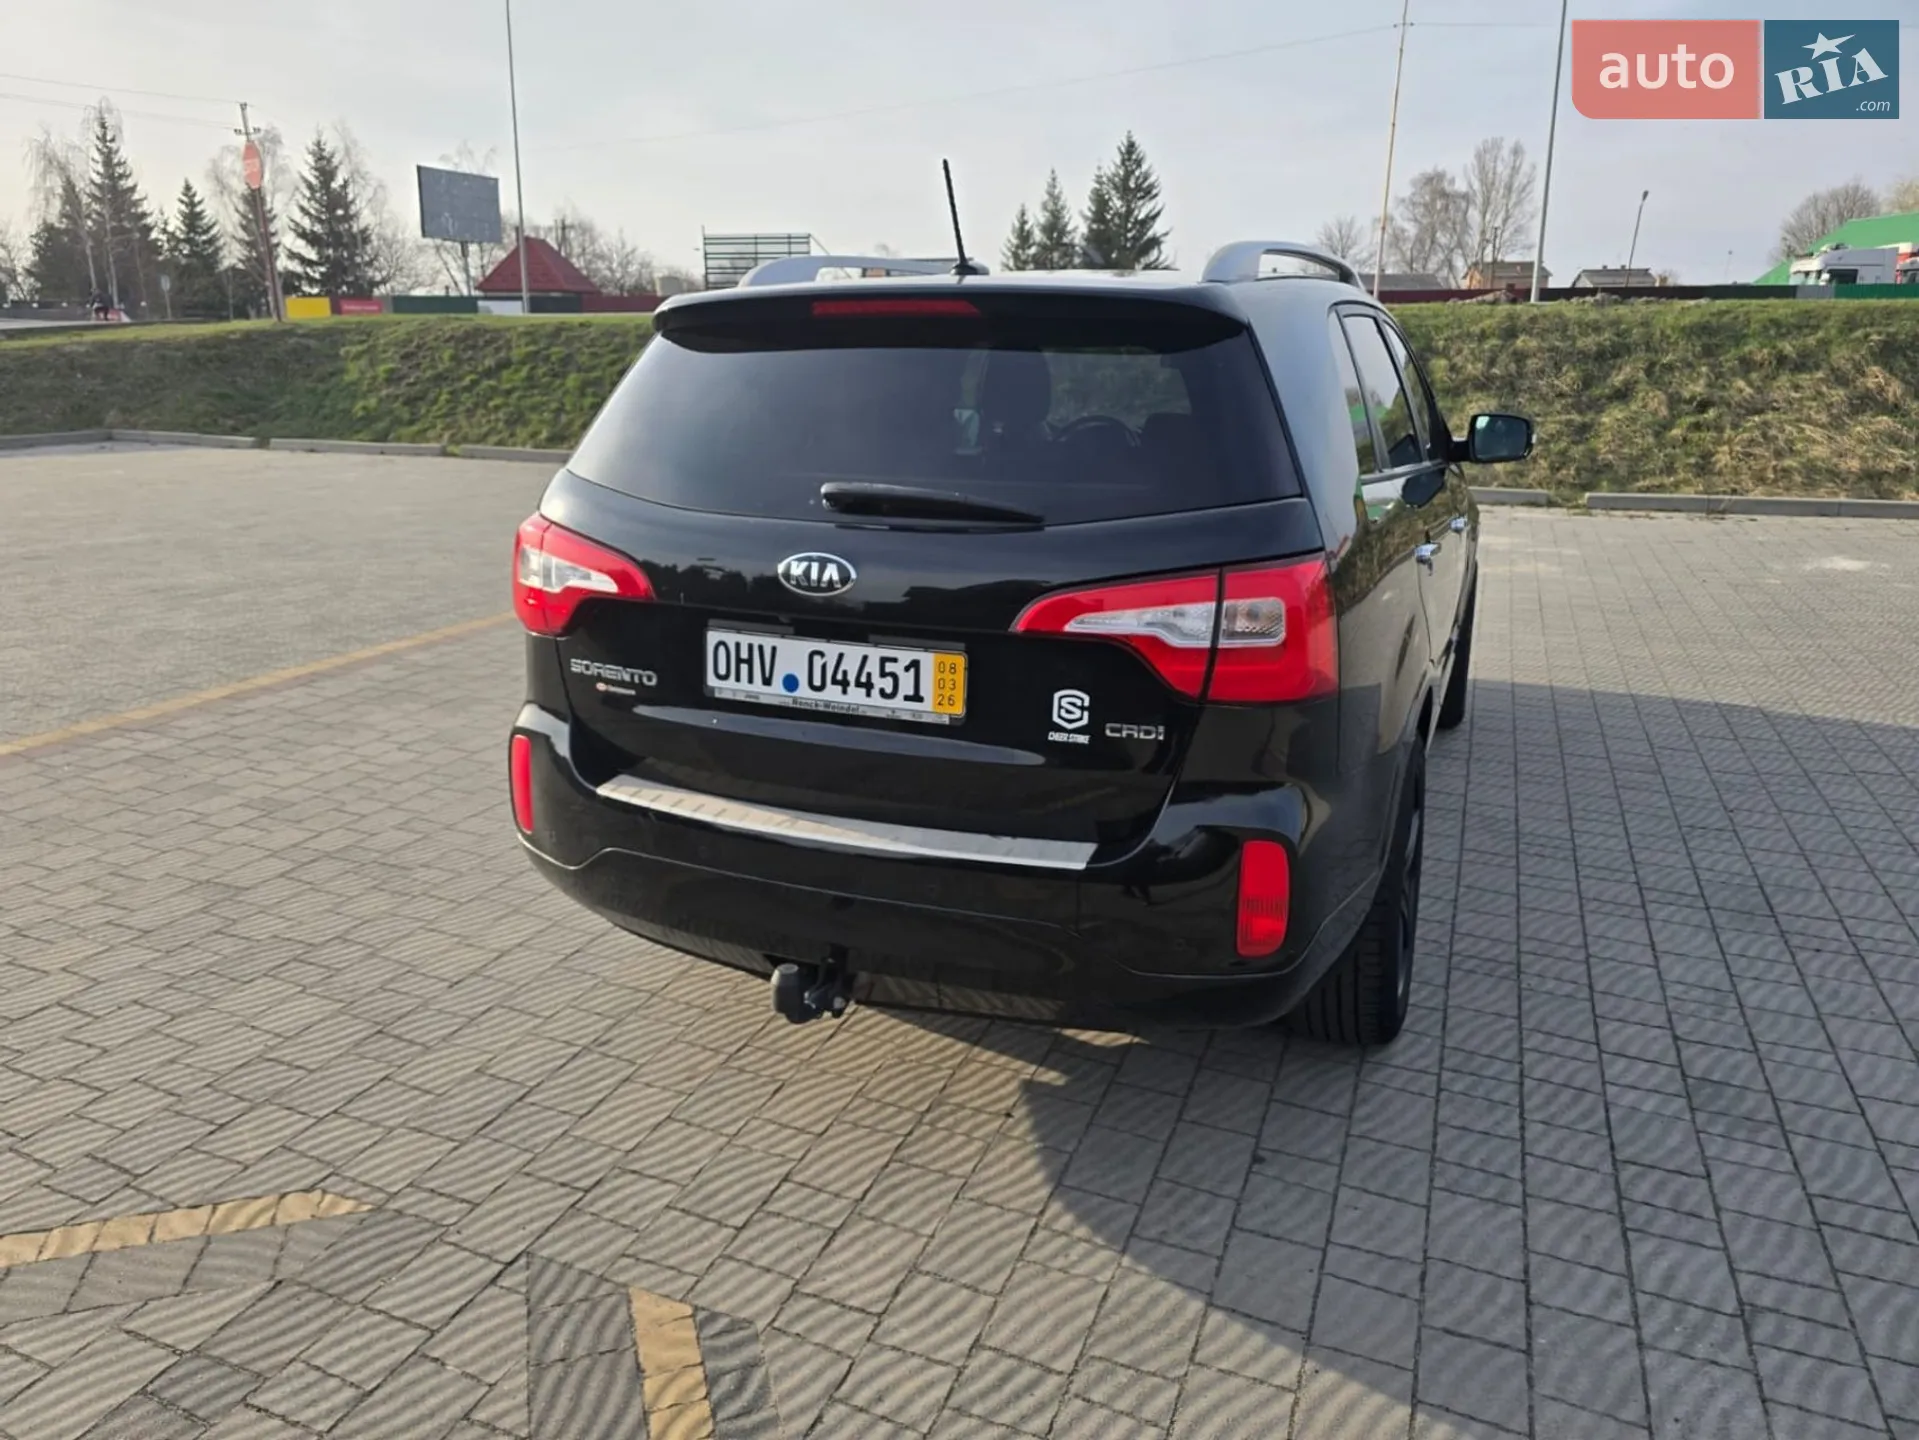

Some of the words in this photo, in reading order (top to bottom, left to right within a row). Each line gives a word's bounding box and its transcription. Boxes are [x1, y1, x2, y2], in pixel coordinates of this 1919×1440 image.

[789, 560, 842, 588] KIA
[570, 658, 657, 686] SORENTO
[712, 640, 777, 687] OHV
[807, 649, 924, 703] 04451
[938, 660, 957, 675] 08
[937, 677, 956, 691] 03
[937, 693, 956, 707] 26
